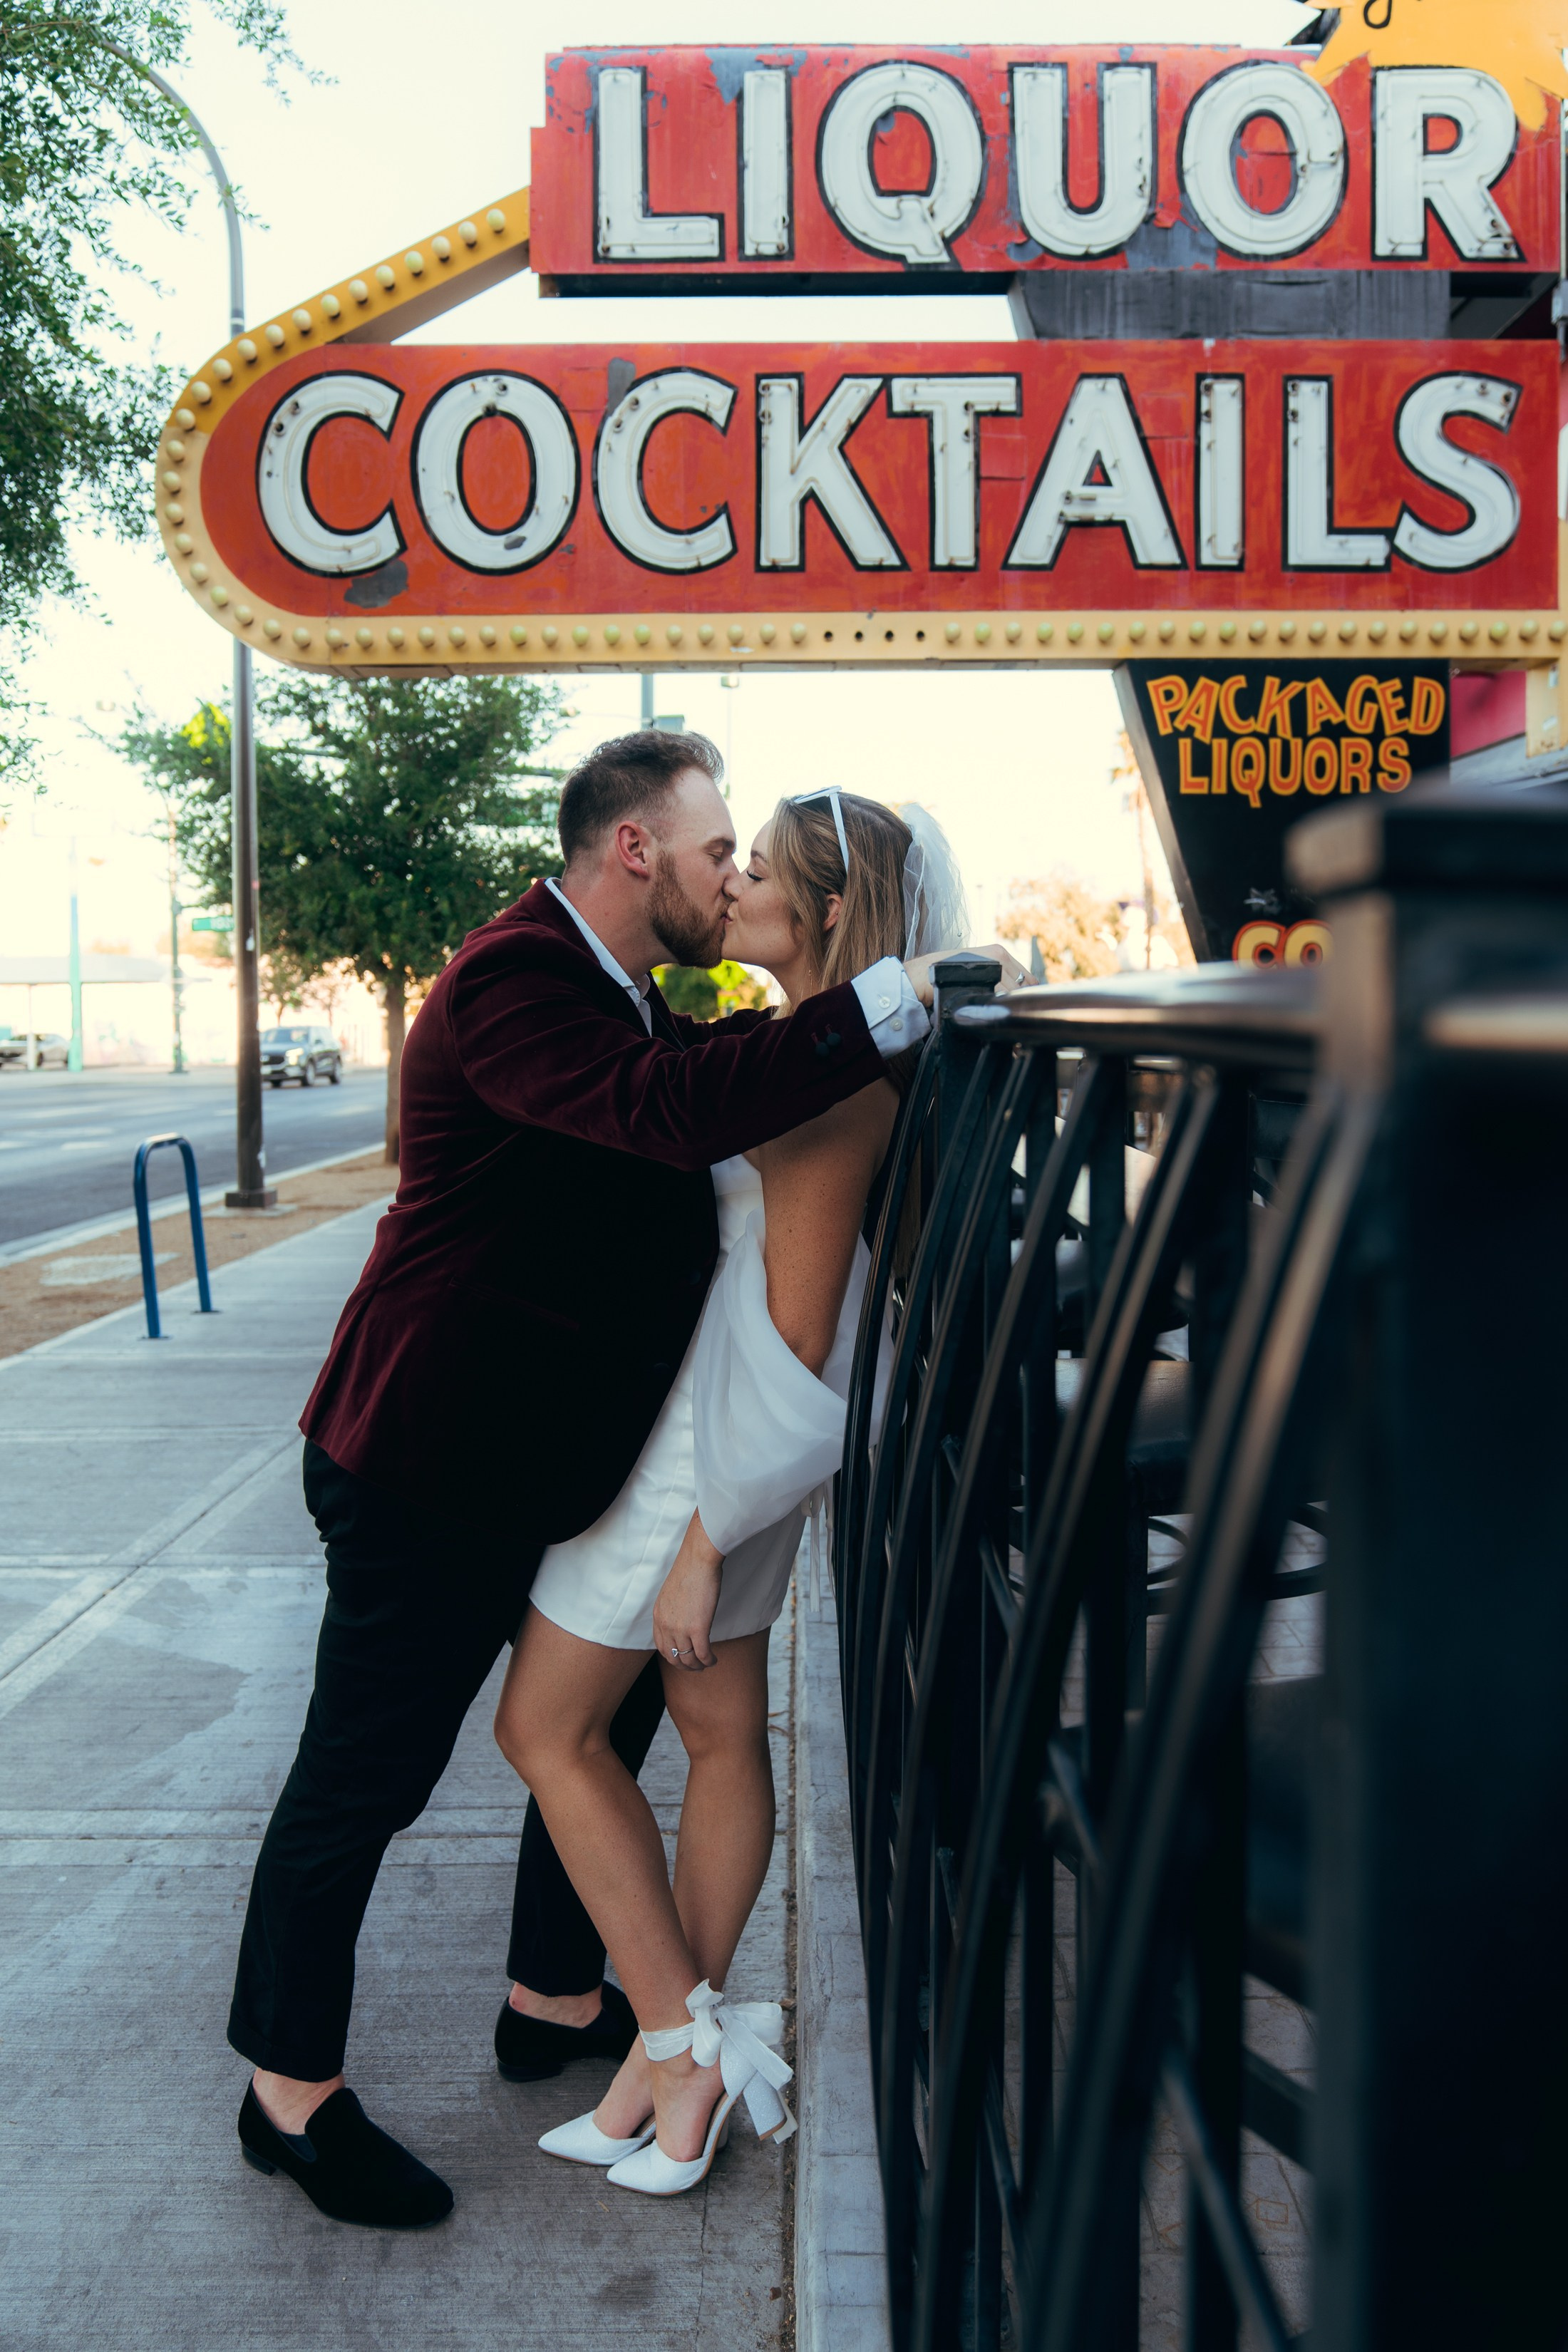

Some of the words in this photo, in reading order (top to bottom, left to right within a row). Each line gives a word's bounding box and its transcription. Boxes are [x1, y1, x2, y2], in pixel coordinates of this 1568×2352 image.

[594, 61, 1522, 266] LIQUOR
[254, 370, 1522, 575] COCKTAILS
[1147, 675, 1445, 744] PACKAGED
[1178, 737, 1410, 808] LIQUORS
